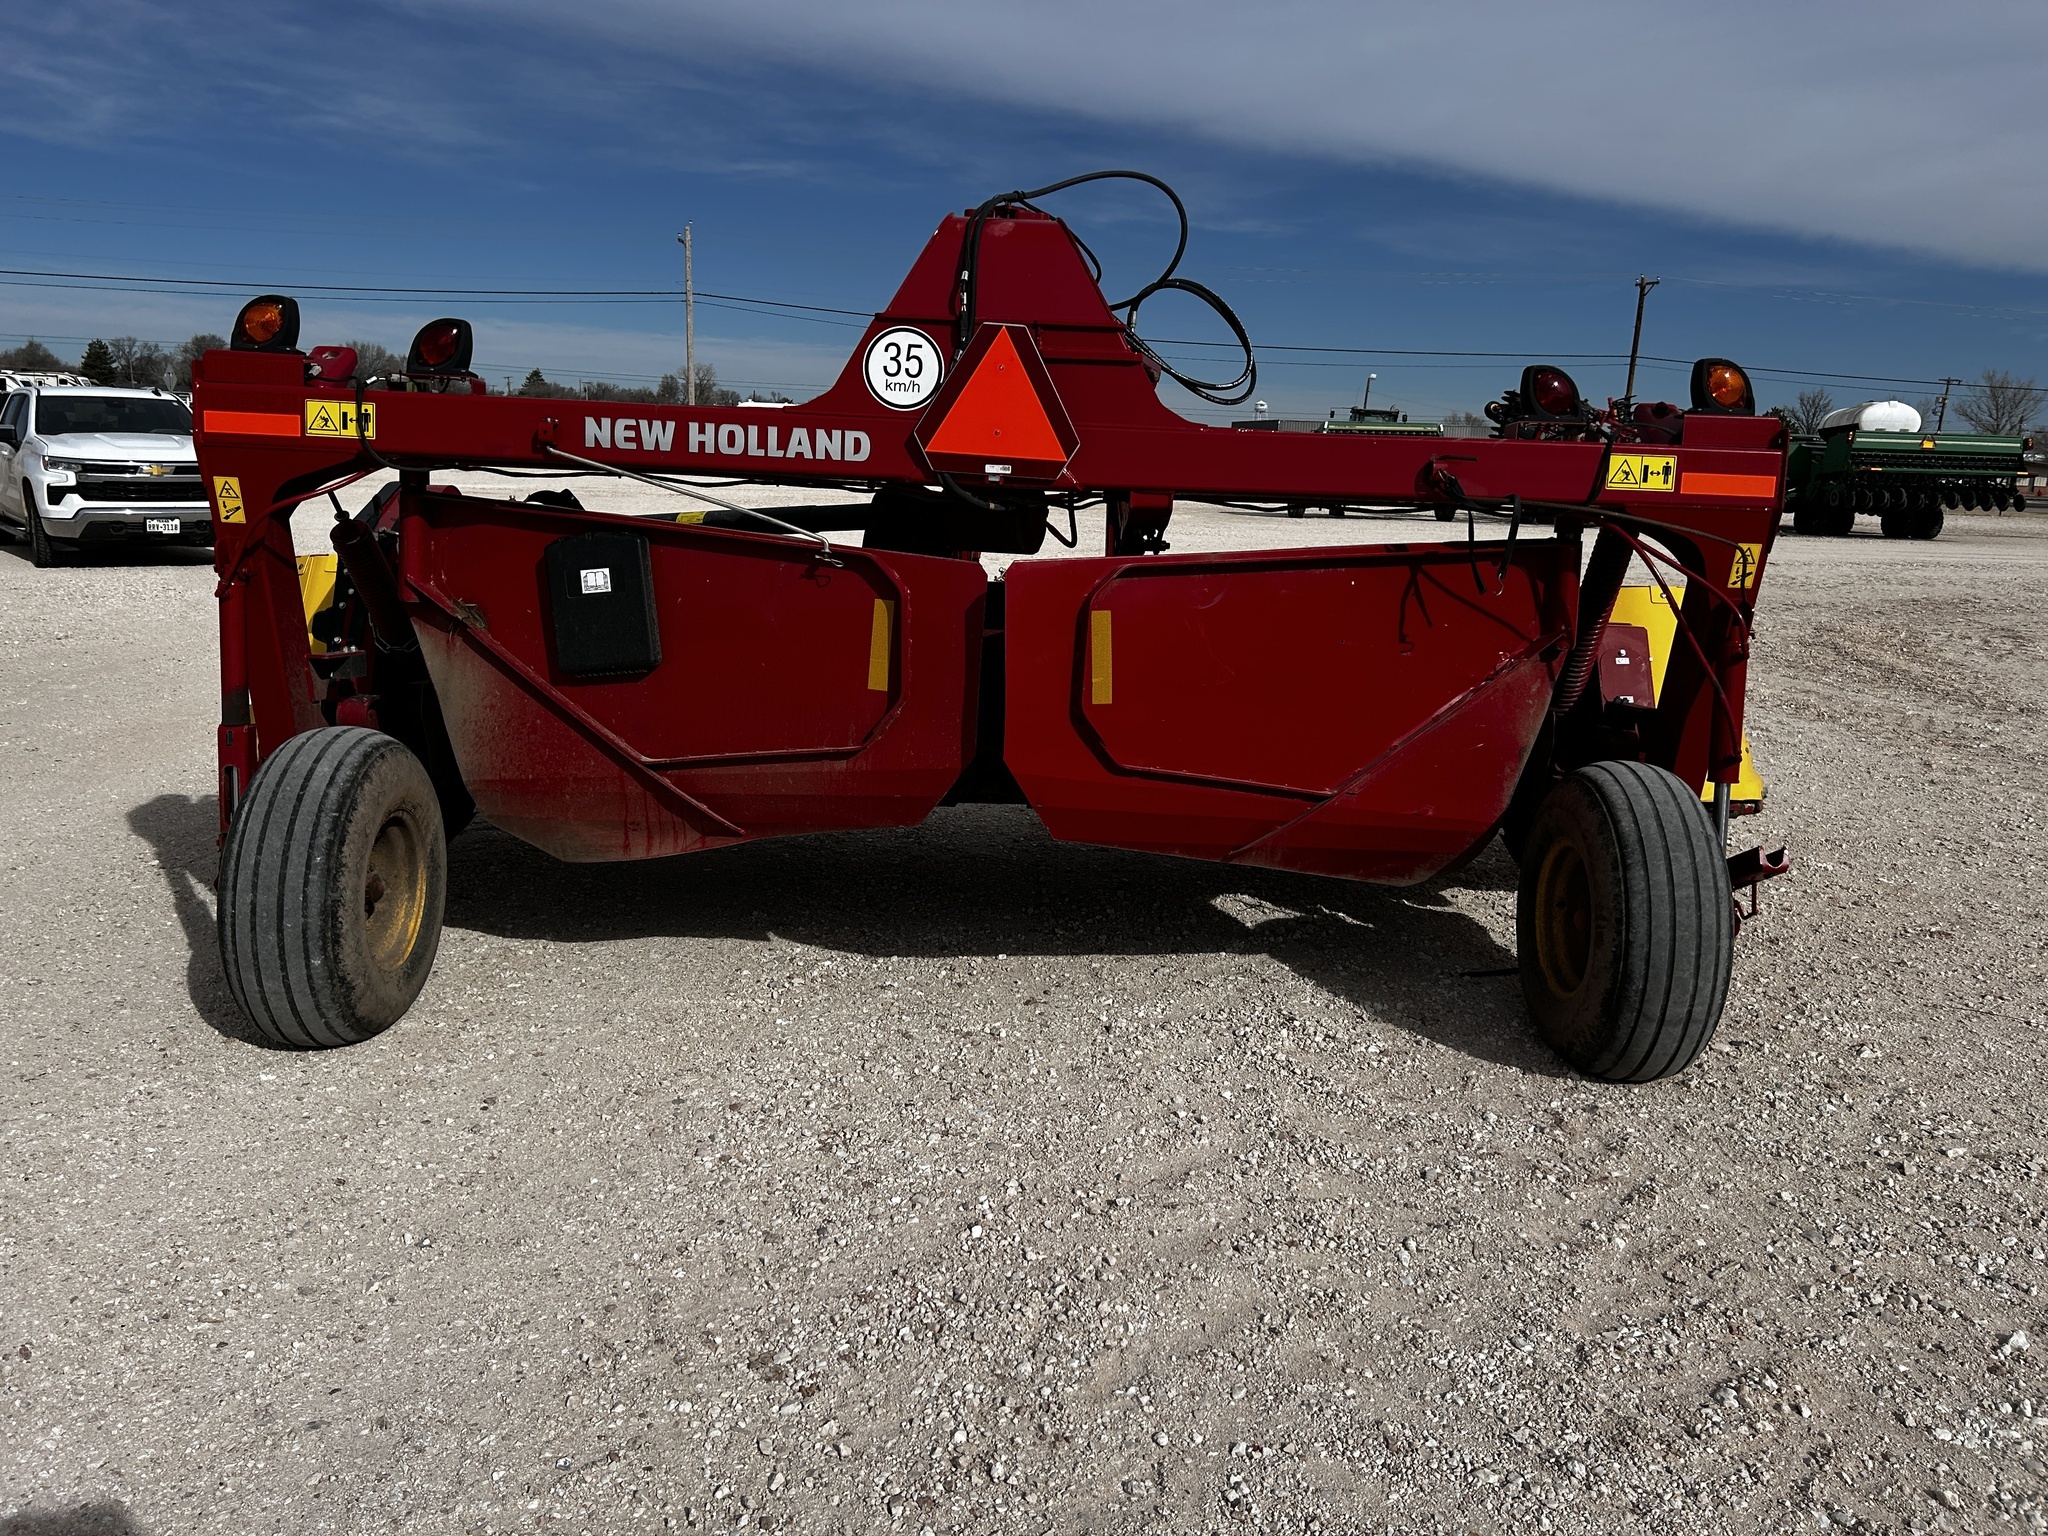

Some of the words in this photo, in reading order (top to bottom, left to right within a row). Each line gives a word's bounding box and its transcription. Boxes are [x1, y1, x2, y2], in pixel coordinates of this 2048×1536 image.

[883, 342, 923, 378] 35
[885, 379, 921, 393] km/h
[584, 416, 676, 451] NEW
[688, 421, 871, 462] HOLLAND
